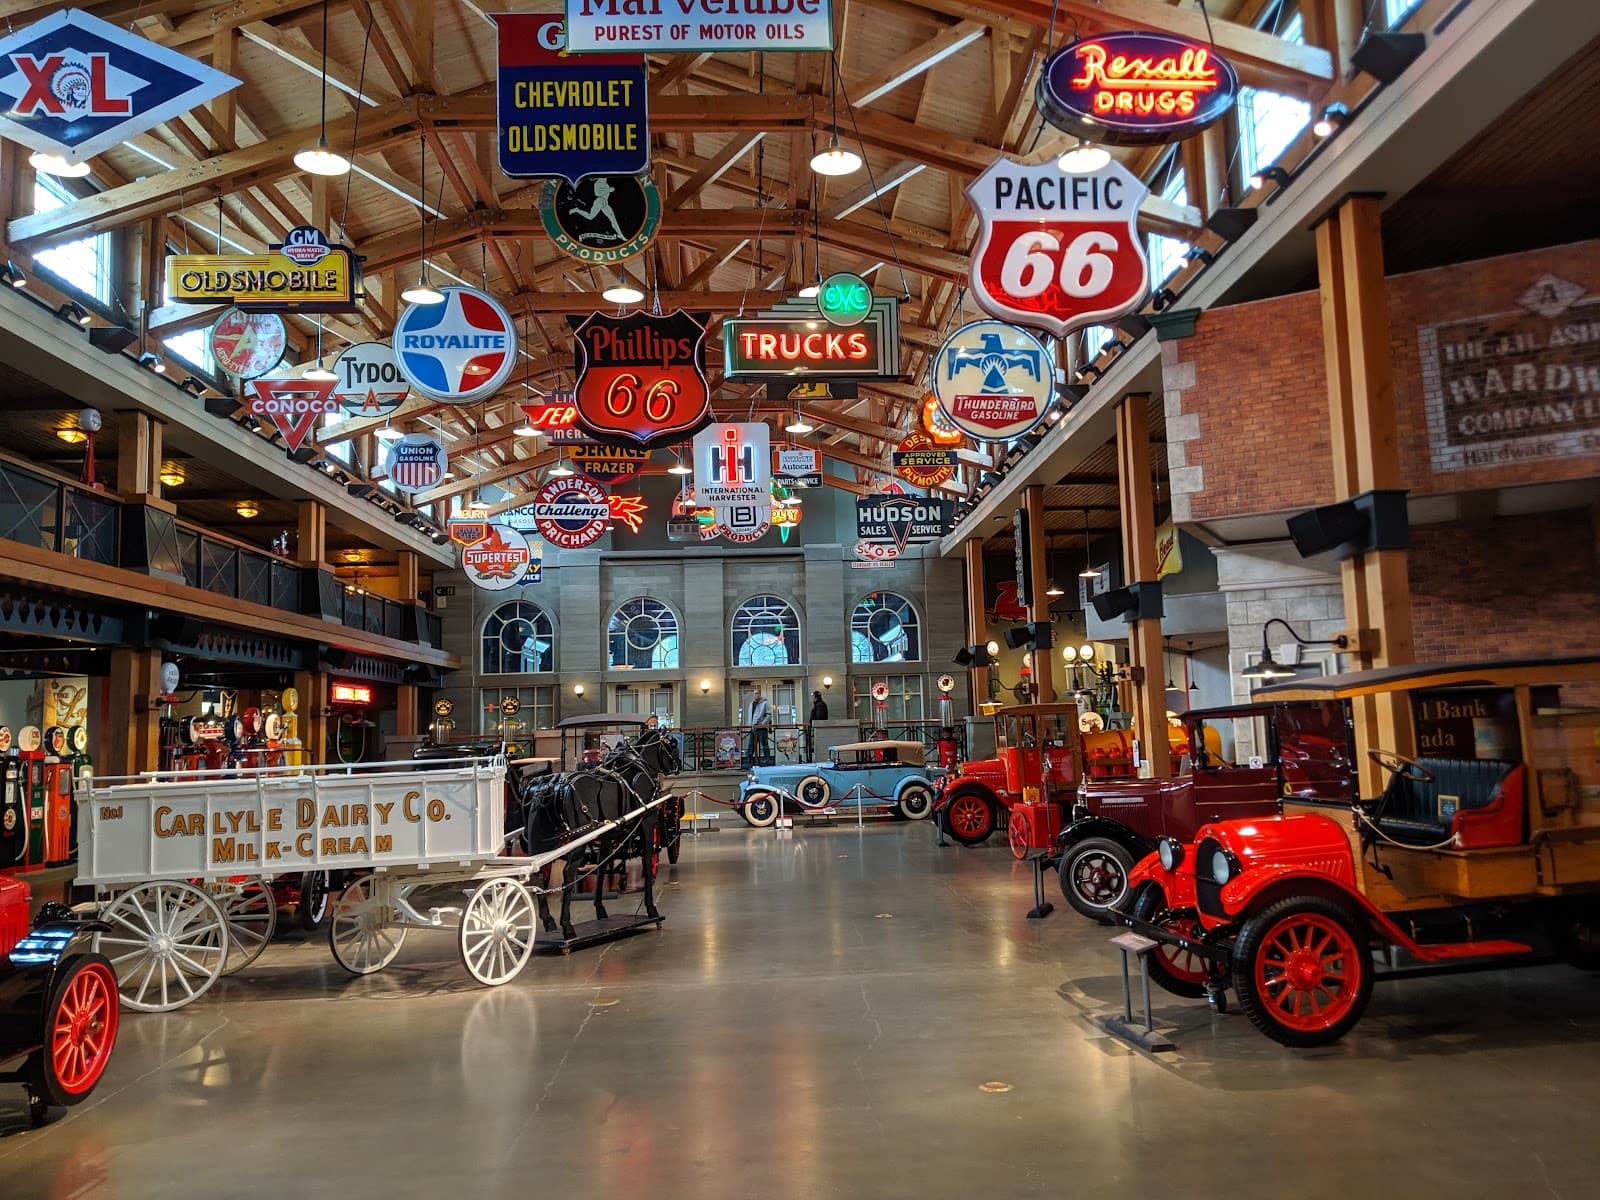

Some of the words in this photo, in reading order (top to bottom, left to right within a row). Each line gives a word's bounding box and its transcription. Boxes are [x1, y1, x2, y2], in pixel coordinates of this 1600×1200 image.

[594, 24, 663, 41] PUREST
[670, 24, 690, 40] OF
[700, 24, 757, 41] MOTOR
[765, 23, 805, 40] OILS
[1073, 43, 1218, 87] Rexall
[514, 79, 634, 109] CHEVROLET
[1097, 91, 1197, 112] DRUGS
[508, 123, 638, 153] OLDSMOBILE
[995, 176, 1124, 210] PACIFIC
[290, 230, 319, 245] GM
[555, 234, 649, 261] PRODUCTS
[999, 230, 1120, 298] 66
[181, 269, 337, 292] OLDSMOBILE
[404, 335, 505, 349] ROYALITE
[586, 325, 693, 370] Phillips
[740, 332, 870, 361] TRUCKS
[1445, 338, 1490, 361] THE
[341, 357, 407, 389] TYDOL
[251, 399, 338, 415] CONOCO
[604, 372, 682, 422] 66
[957, 397, 1036, 411] THUNDERBIRD
[970, 410, 1019, 420] GASOLINE
[1457, 401, 1575, 436] COMPANY
[400, 447, 433, 455] UNION
[575, 445, 648, 457] SERVICE
[901, 457, 951, 465] SERVICE
[1463, 437, 1557, 466] Hardware
[585, 462, 635, 474] FRAZER
[902, 466, 950, 486] PLYMOUTH
[542, 478, 604, 503] ANDERSON
[701, 486, 765, 494] INTERNATIONAL
[537, 504, 607, 518] Challenge
[859, 506, 941, 522] HUDSON
[541, 520, 604, 545] PRICHARD
[718, 520, 770, 543] PRODUCTS
[860, 525, 887, 535] SALES
[912, 524, 942, 534] SERVICE
[467, 550, 526, 564] SUPERTEST
[1437, 699, 1488, 719] Bank
